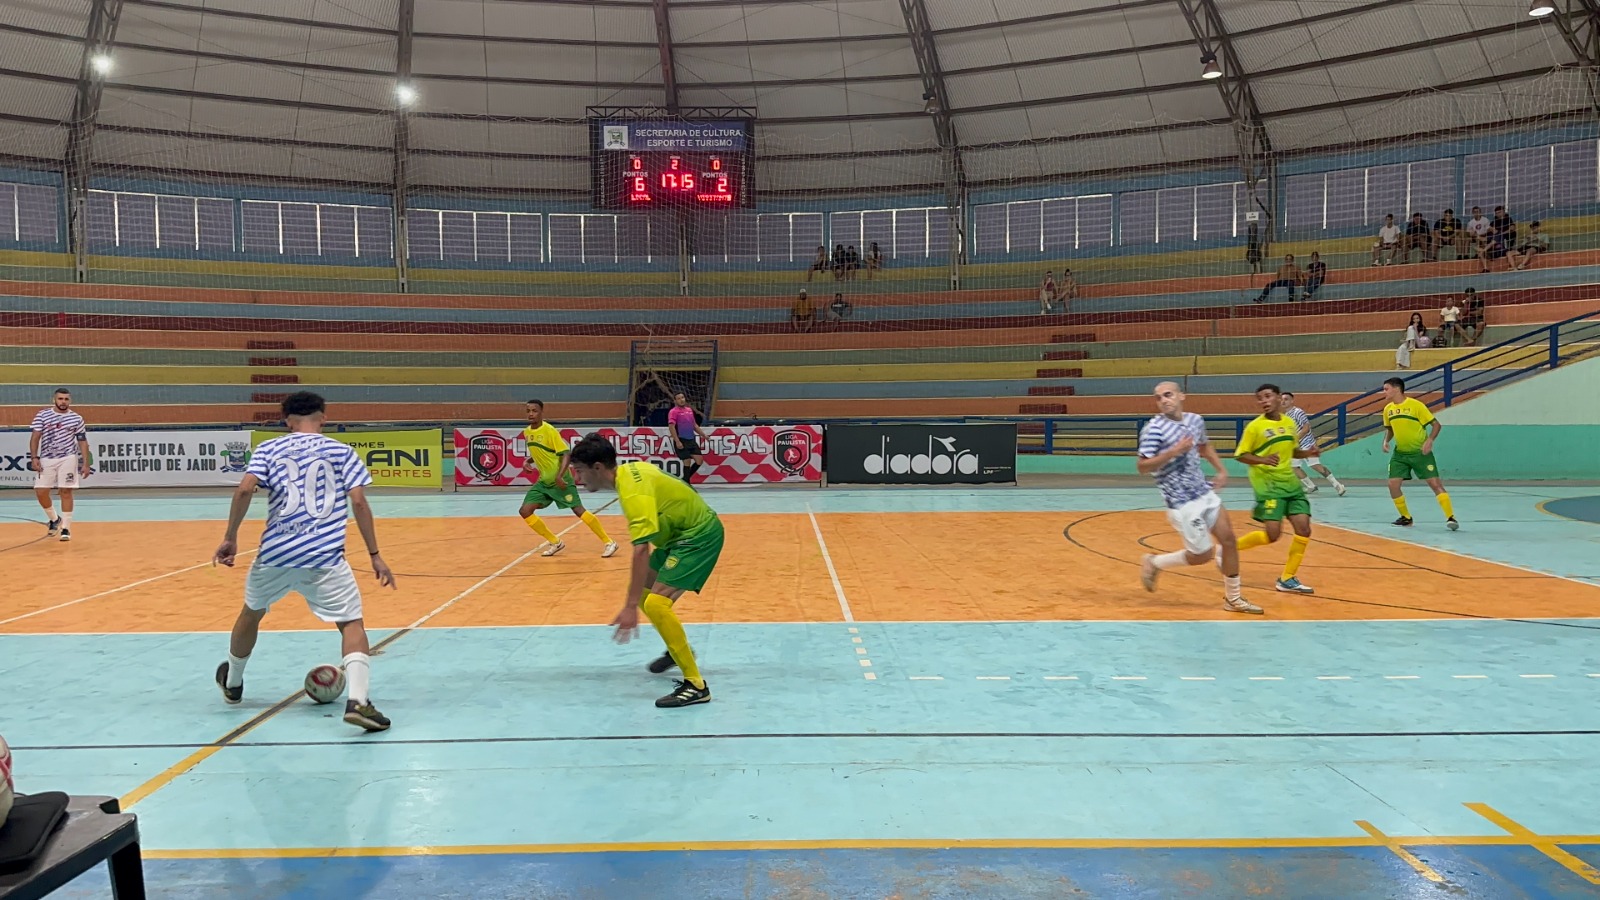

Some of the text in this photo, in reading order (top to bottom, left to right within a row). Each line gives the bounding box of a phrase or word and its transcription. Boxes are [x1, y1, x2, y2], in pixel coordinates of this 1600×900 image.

[635, 129, 688, 137] SECRETARIA
[689, 129, 701, 137] DE
[647, 139, 733, 147] ESPORTE E TURISMO
[634, 159, 641, 170] 0
[671, 159, 678, 170] 2
[713, 159, 720, 170] 0
[635, 177, 645, 191] 6
[718, 178, 728, 192] 2
[98, 443, 216, 457] PREFEITURA DO
[347, 441, 385, 449] RMES
[695, 434, 767, 455] UTSAL
[366, 449, 429, 467] ANI
[863, 434, 979, 475] diadora
[99, 456, 217, 473] MUNICÍPIO DE JAHU
[370, 469, 432, 478] PORTES
[276, 457, 336, 520] 30
